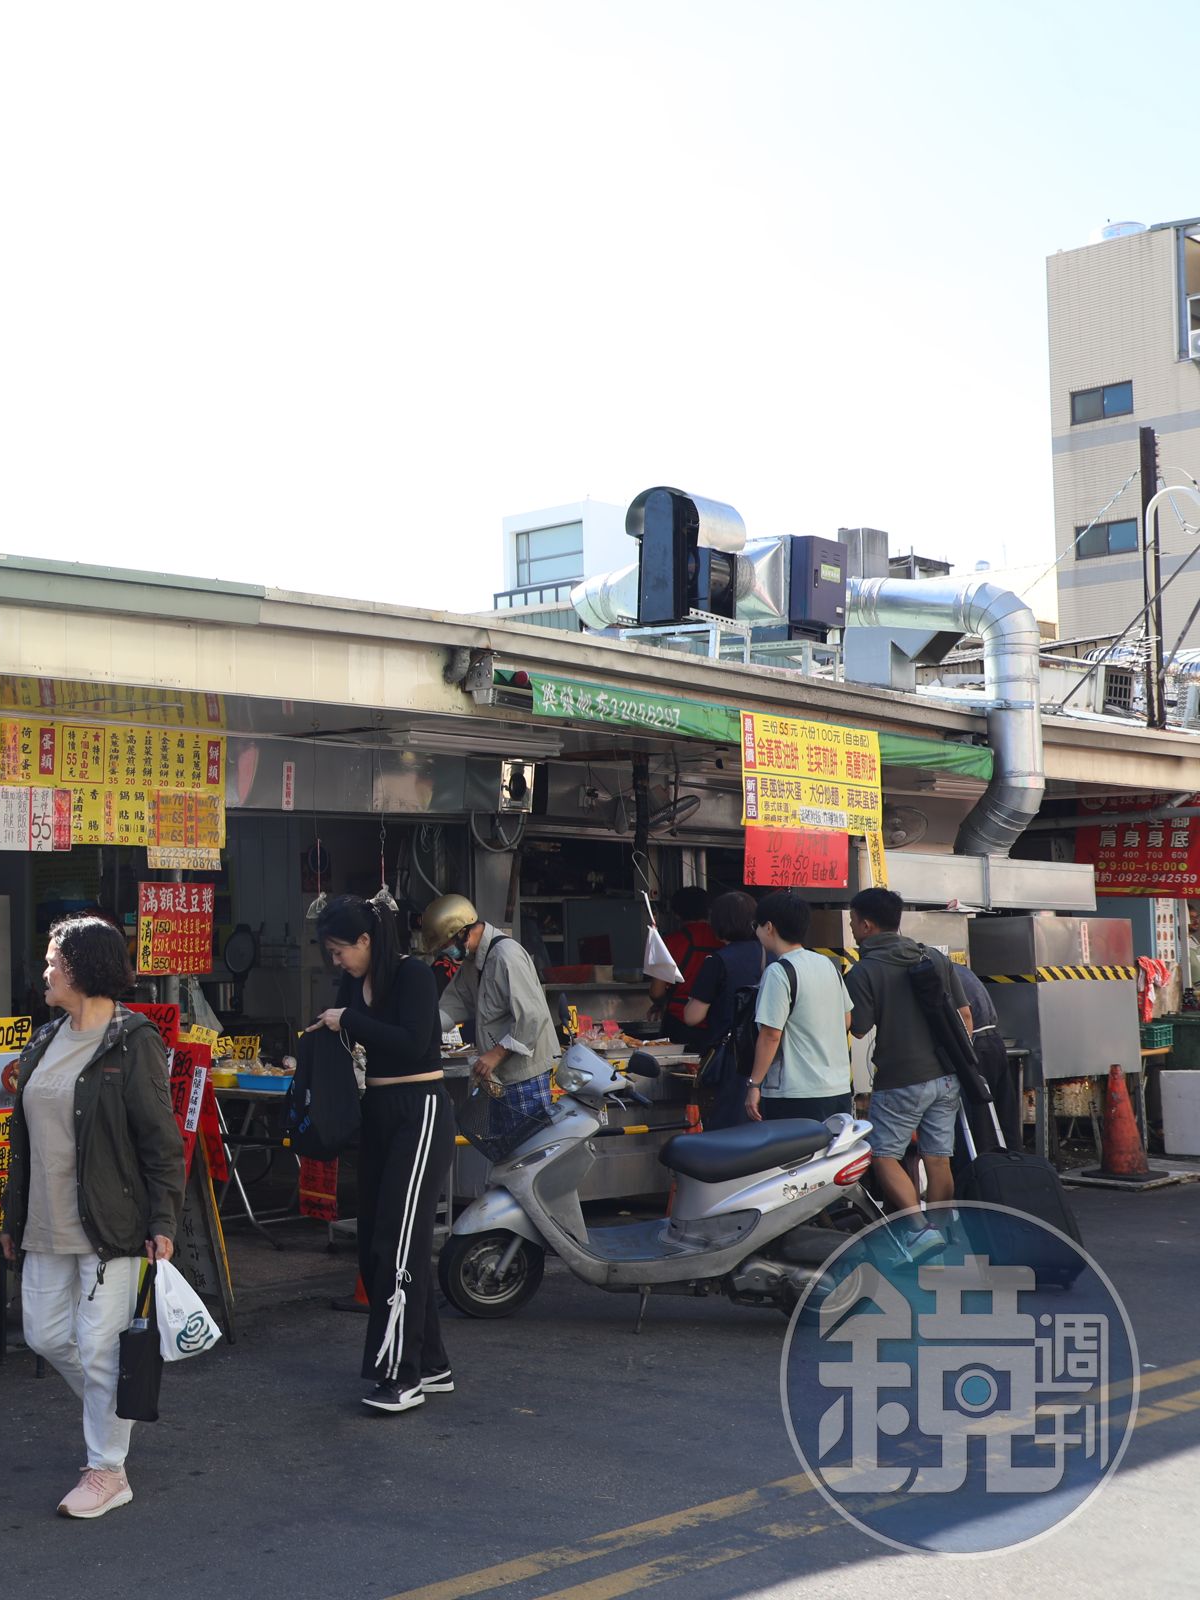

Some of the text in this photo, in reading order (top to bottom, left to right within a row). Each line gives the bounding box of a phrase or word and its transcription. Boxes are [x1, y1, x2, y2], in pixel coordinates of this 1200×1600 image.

[21, 727, 32, 770] 荷包蛋
[40, 733, 54, 771] 蛋類
[79, 731, 89, 779] 3個自由配
[92, 745, 100, 766] 特價
[744, 718, 756, 764] 最低價
[21, 772, 31, 780] 15
[208, 746, 219, 780] 餅類
[160, 779, 169, 787] 20
[746, 779, 757, 817] 新產品
[32, 812, 51, 841] 55
[143, 887, 213, 914] 滿額送豆漿
[141, 920, 152, 968] 消費
[217, 1037, 234, 1055] 55
[238, 1046, 254, 1060] 50
